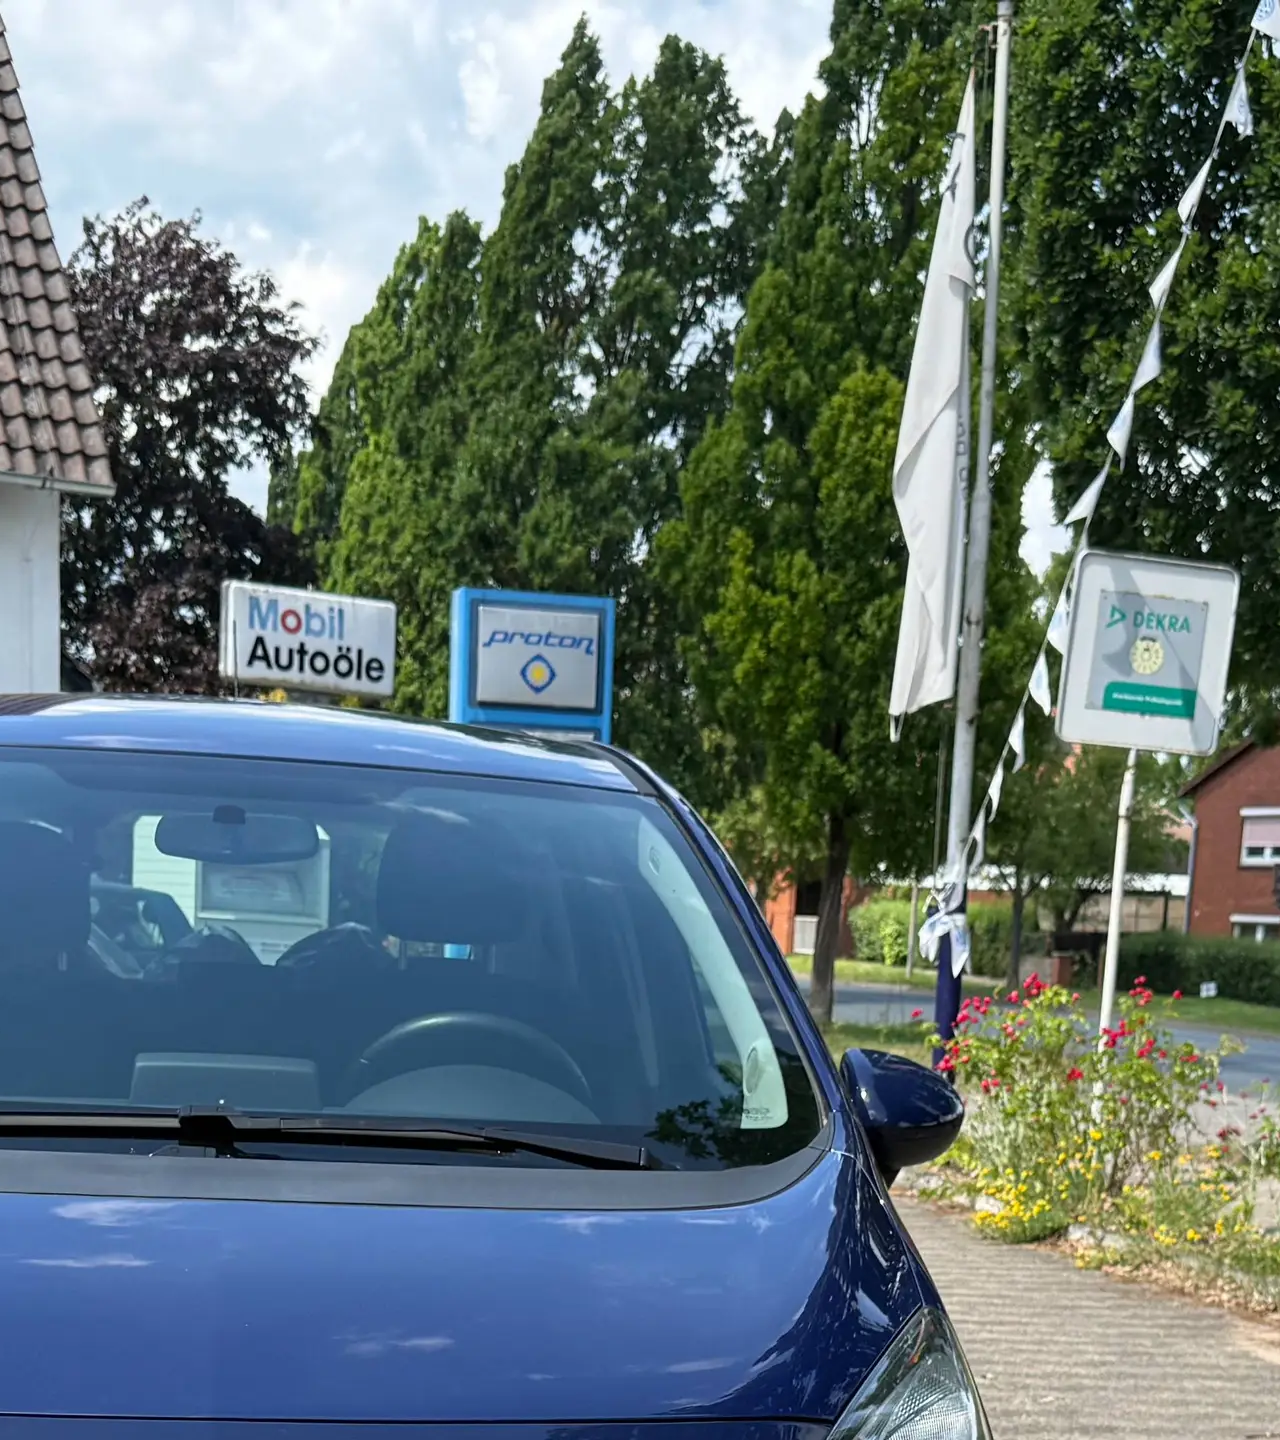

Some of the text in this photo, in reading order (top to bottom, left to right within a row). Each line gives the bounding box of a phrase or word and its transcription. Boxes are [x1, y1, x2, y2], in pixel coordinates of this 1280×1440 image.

[248, 596, 345, 640] Mobil
[1133, 611, 1191, 633] DEKRA
[246, 636, 385, 682] Autoöle
[482, 629, 594, 655] proton
